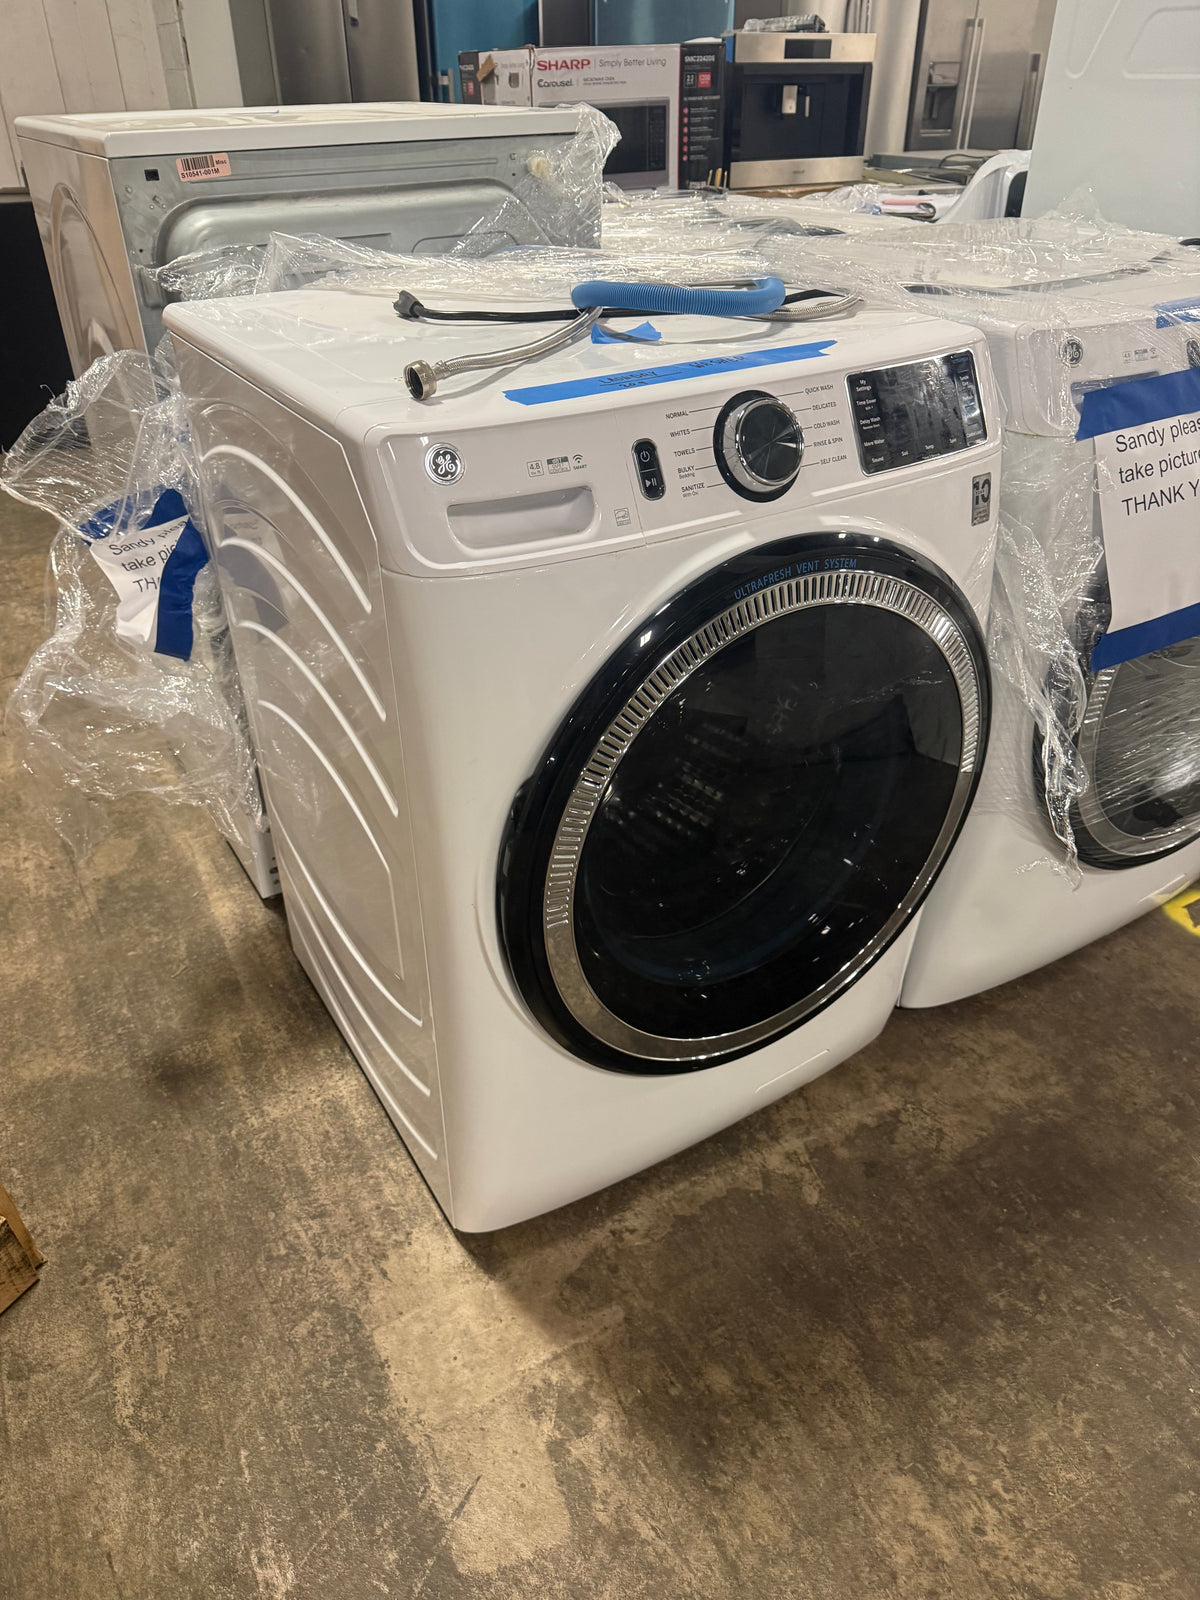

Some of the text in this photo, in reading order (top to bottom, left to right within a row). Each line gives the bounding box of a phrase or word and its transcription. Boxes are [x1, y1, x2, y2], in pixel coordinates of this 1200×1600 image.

[537, 59, 590, 71] SHARP
[599, 58, 667, 68] Simply Better Living
[537, 78, 573, 88] Carousel
[598, 371, 658, 384] LAUNDRY
[820, 384, 834, 392] WASH
[812, 402, 837, 411] DELICATES
[665, 410, 689, 420] NORMAL
[813, 419, 840, 430] COLD WASH
[669, 428, 691, 438] WHITES
[813, 439, 828, 447] RINSE
[1115, 426, 1165, 453] Sandy
[674, 447, 696, 458] TOWELS
[831, 455, 847, 463] CLEAN
[529, 462, 541, 470] 4.8
[677, 465, 695, 474] BULKY
[1119, 449, 1200, 484] take pictur
[681, 482, 706, 492] SANITIZE
[973, 479, 991, 505] 10
[1121, 483, 1185, 516] THANK
[109, 537, 156, 556] Sandy
[121, 555, 156, 572] take
[133, 576, 161, 593] TH
[734, 558, 857, 600] ULTRAFRESH VENT SYSTEM
